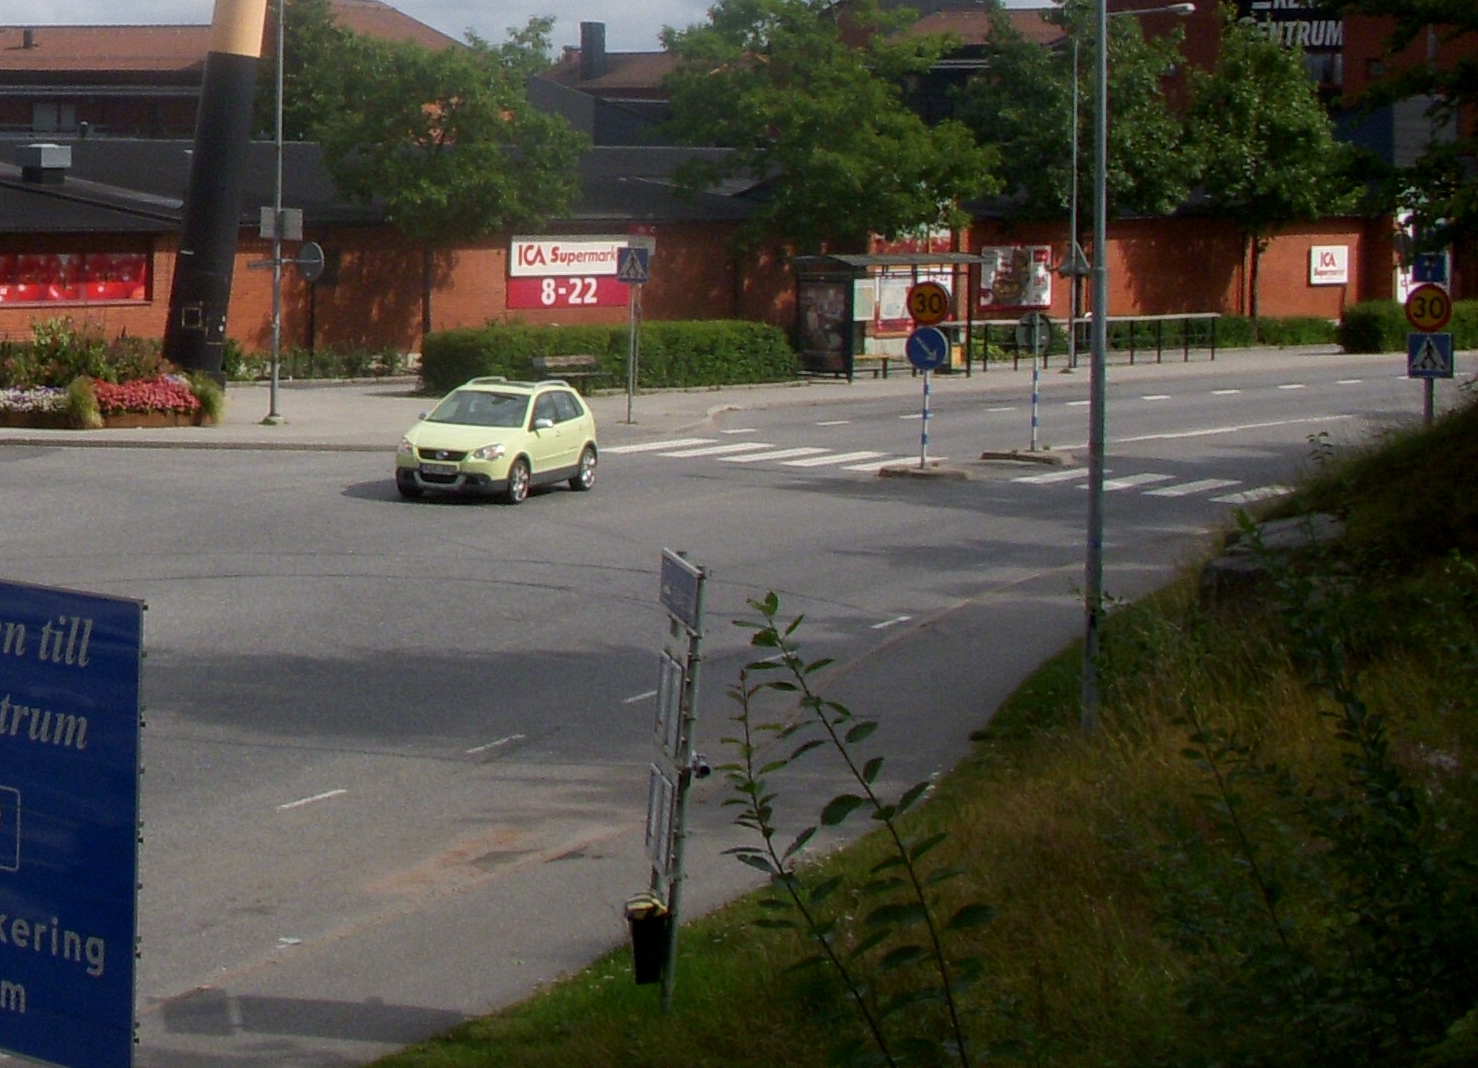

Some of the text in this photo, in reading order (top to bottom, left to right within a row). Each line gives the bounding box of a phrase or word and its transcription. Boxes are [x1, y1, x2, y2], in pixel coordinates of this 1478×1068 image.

[518, 245, 619, 266] ICA Supermark
[1321, 251, 1336, 267] ICA
[541, 277, 597, 305] 8-22
[914, 293, 942, 314] 30
[1413, 297, 1444, 319] 30
[39, 615, 93, 667] till
